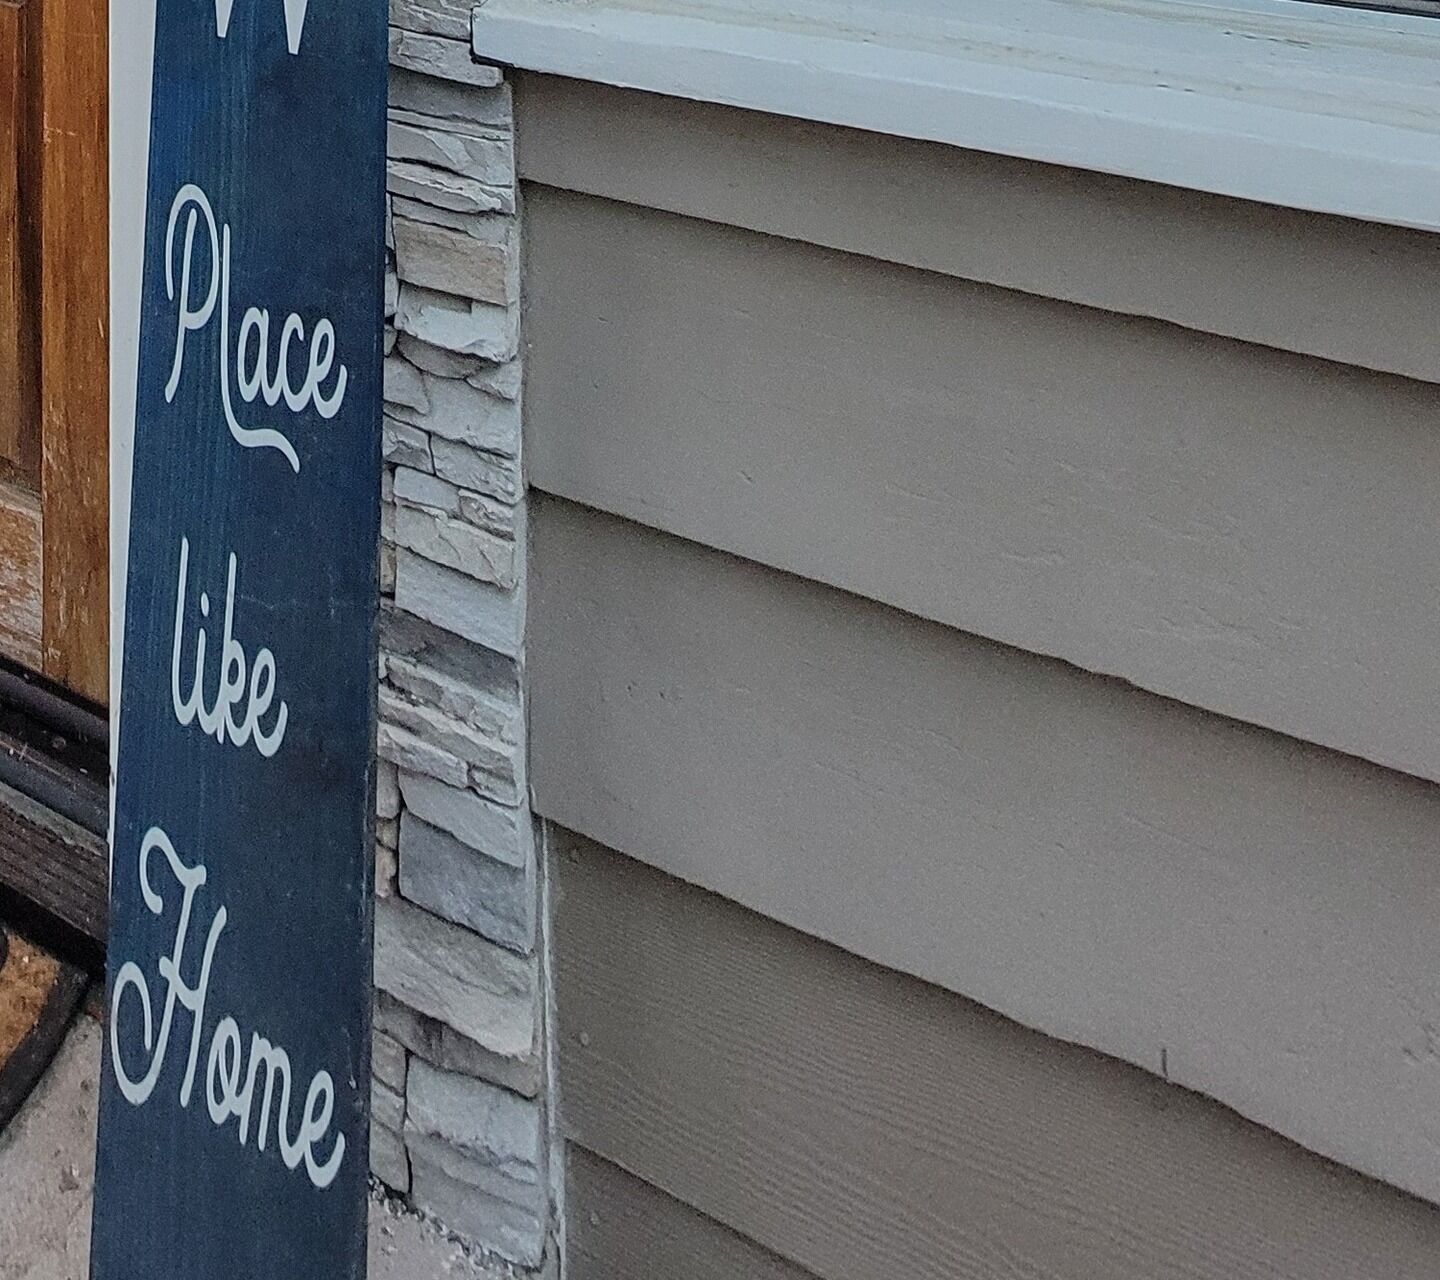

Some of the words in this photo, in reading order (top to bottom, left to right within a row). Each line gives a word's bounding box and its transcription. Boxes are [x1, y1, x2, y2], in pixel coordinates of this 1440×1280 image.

[164, 183, 348, 473] Place
[171, 537, 288, 757] like
[110, 826, 346, 1188] Home
